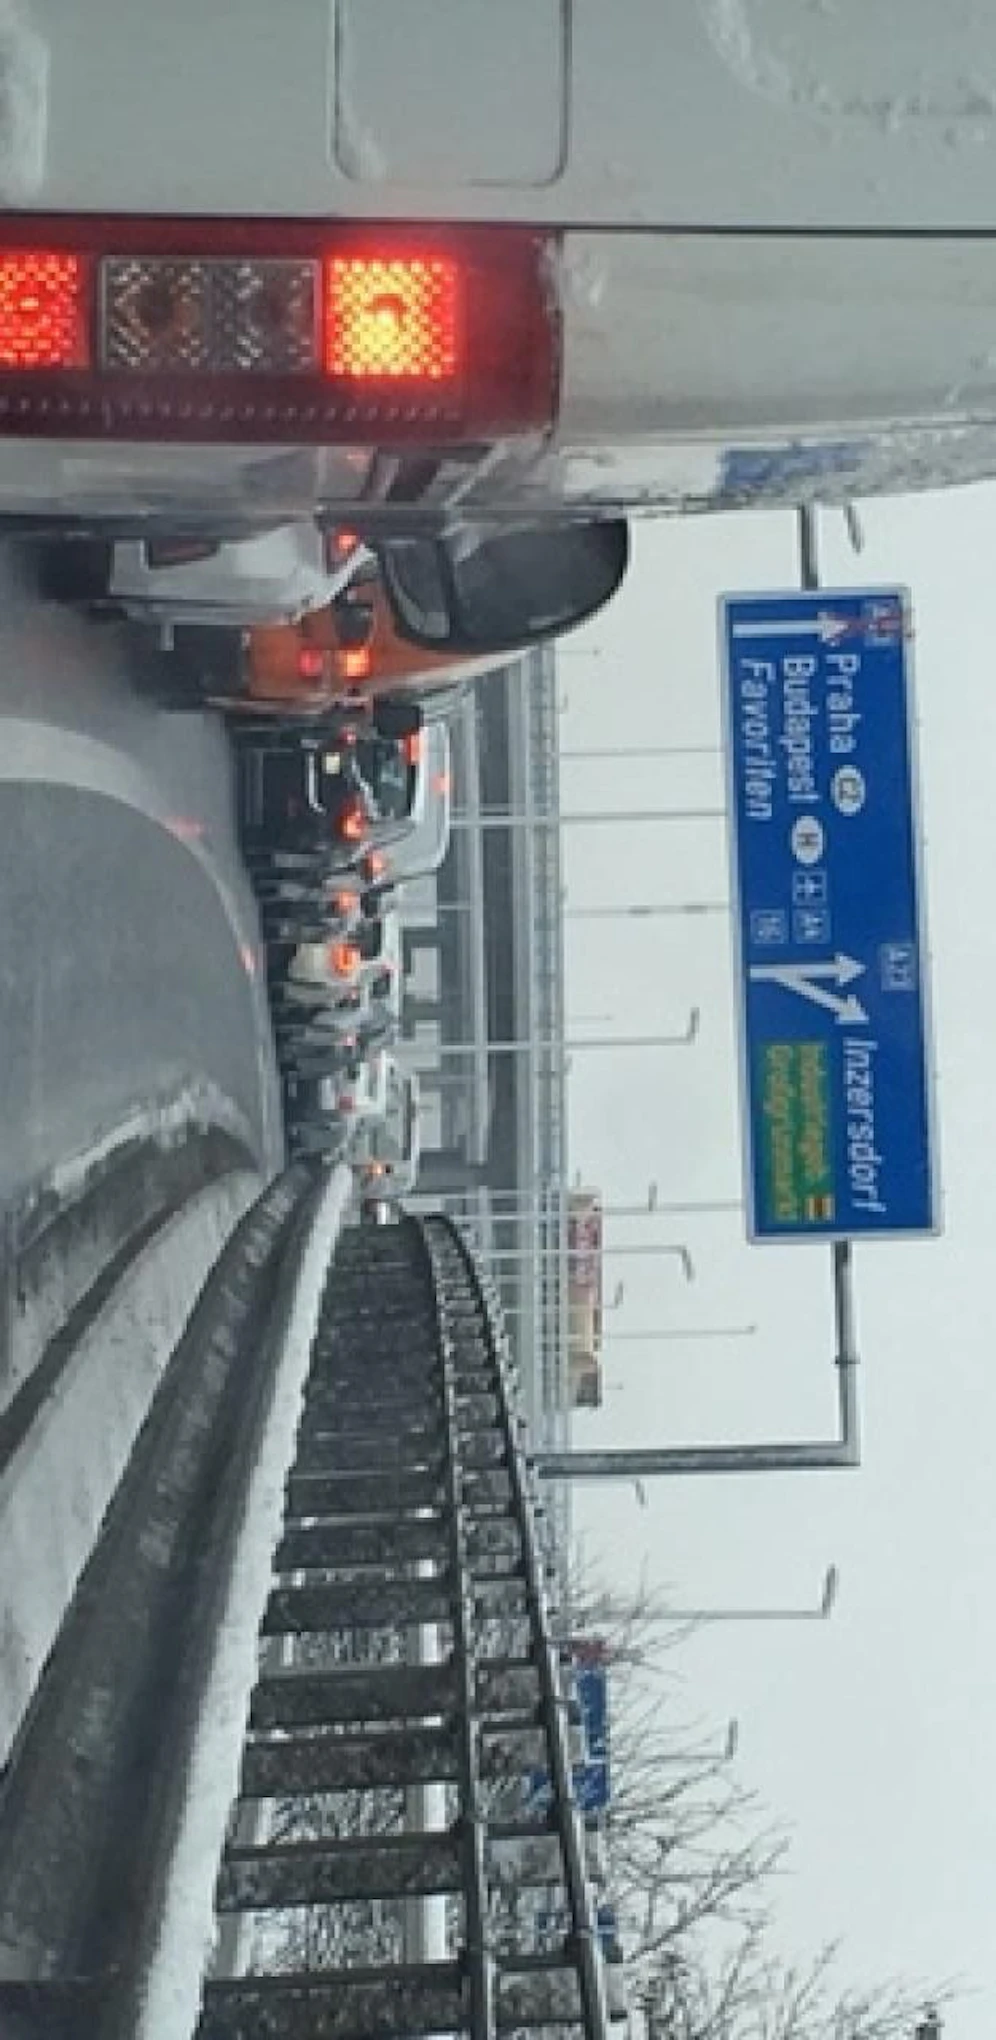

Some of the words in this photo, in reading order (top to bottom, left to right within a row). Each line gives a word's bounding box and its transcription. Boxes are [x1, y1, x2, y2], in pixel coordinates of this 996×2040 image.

[740, 659, 777, 818] Favoriten
[779, 656, 821, 802] Budapest
[826, 654, 861, 754] Praha
[797, 832, 819, 848] H
[843, 1037, 887, 1213] Inzersdorf
